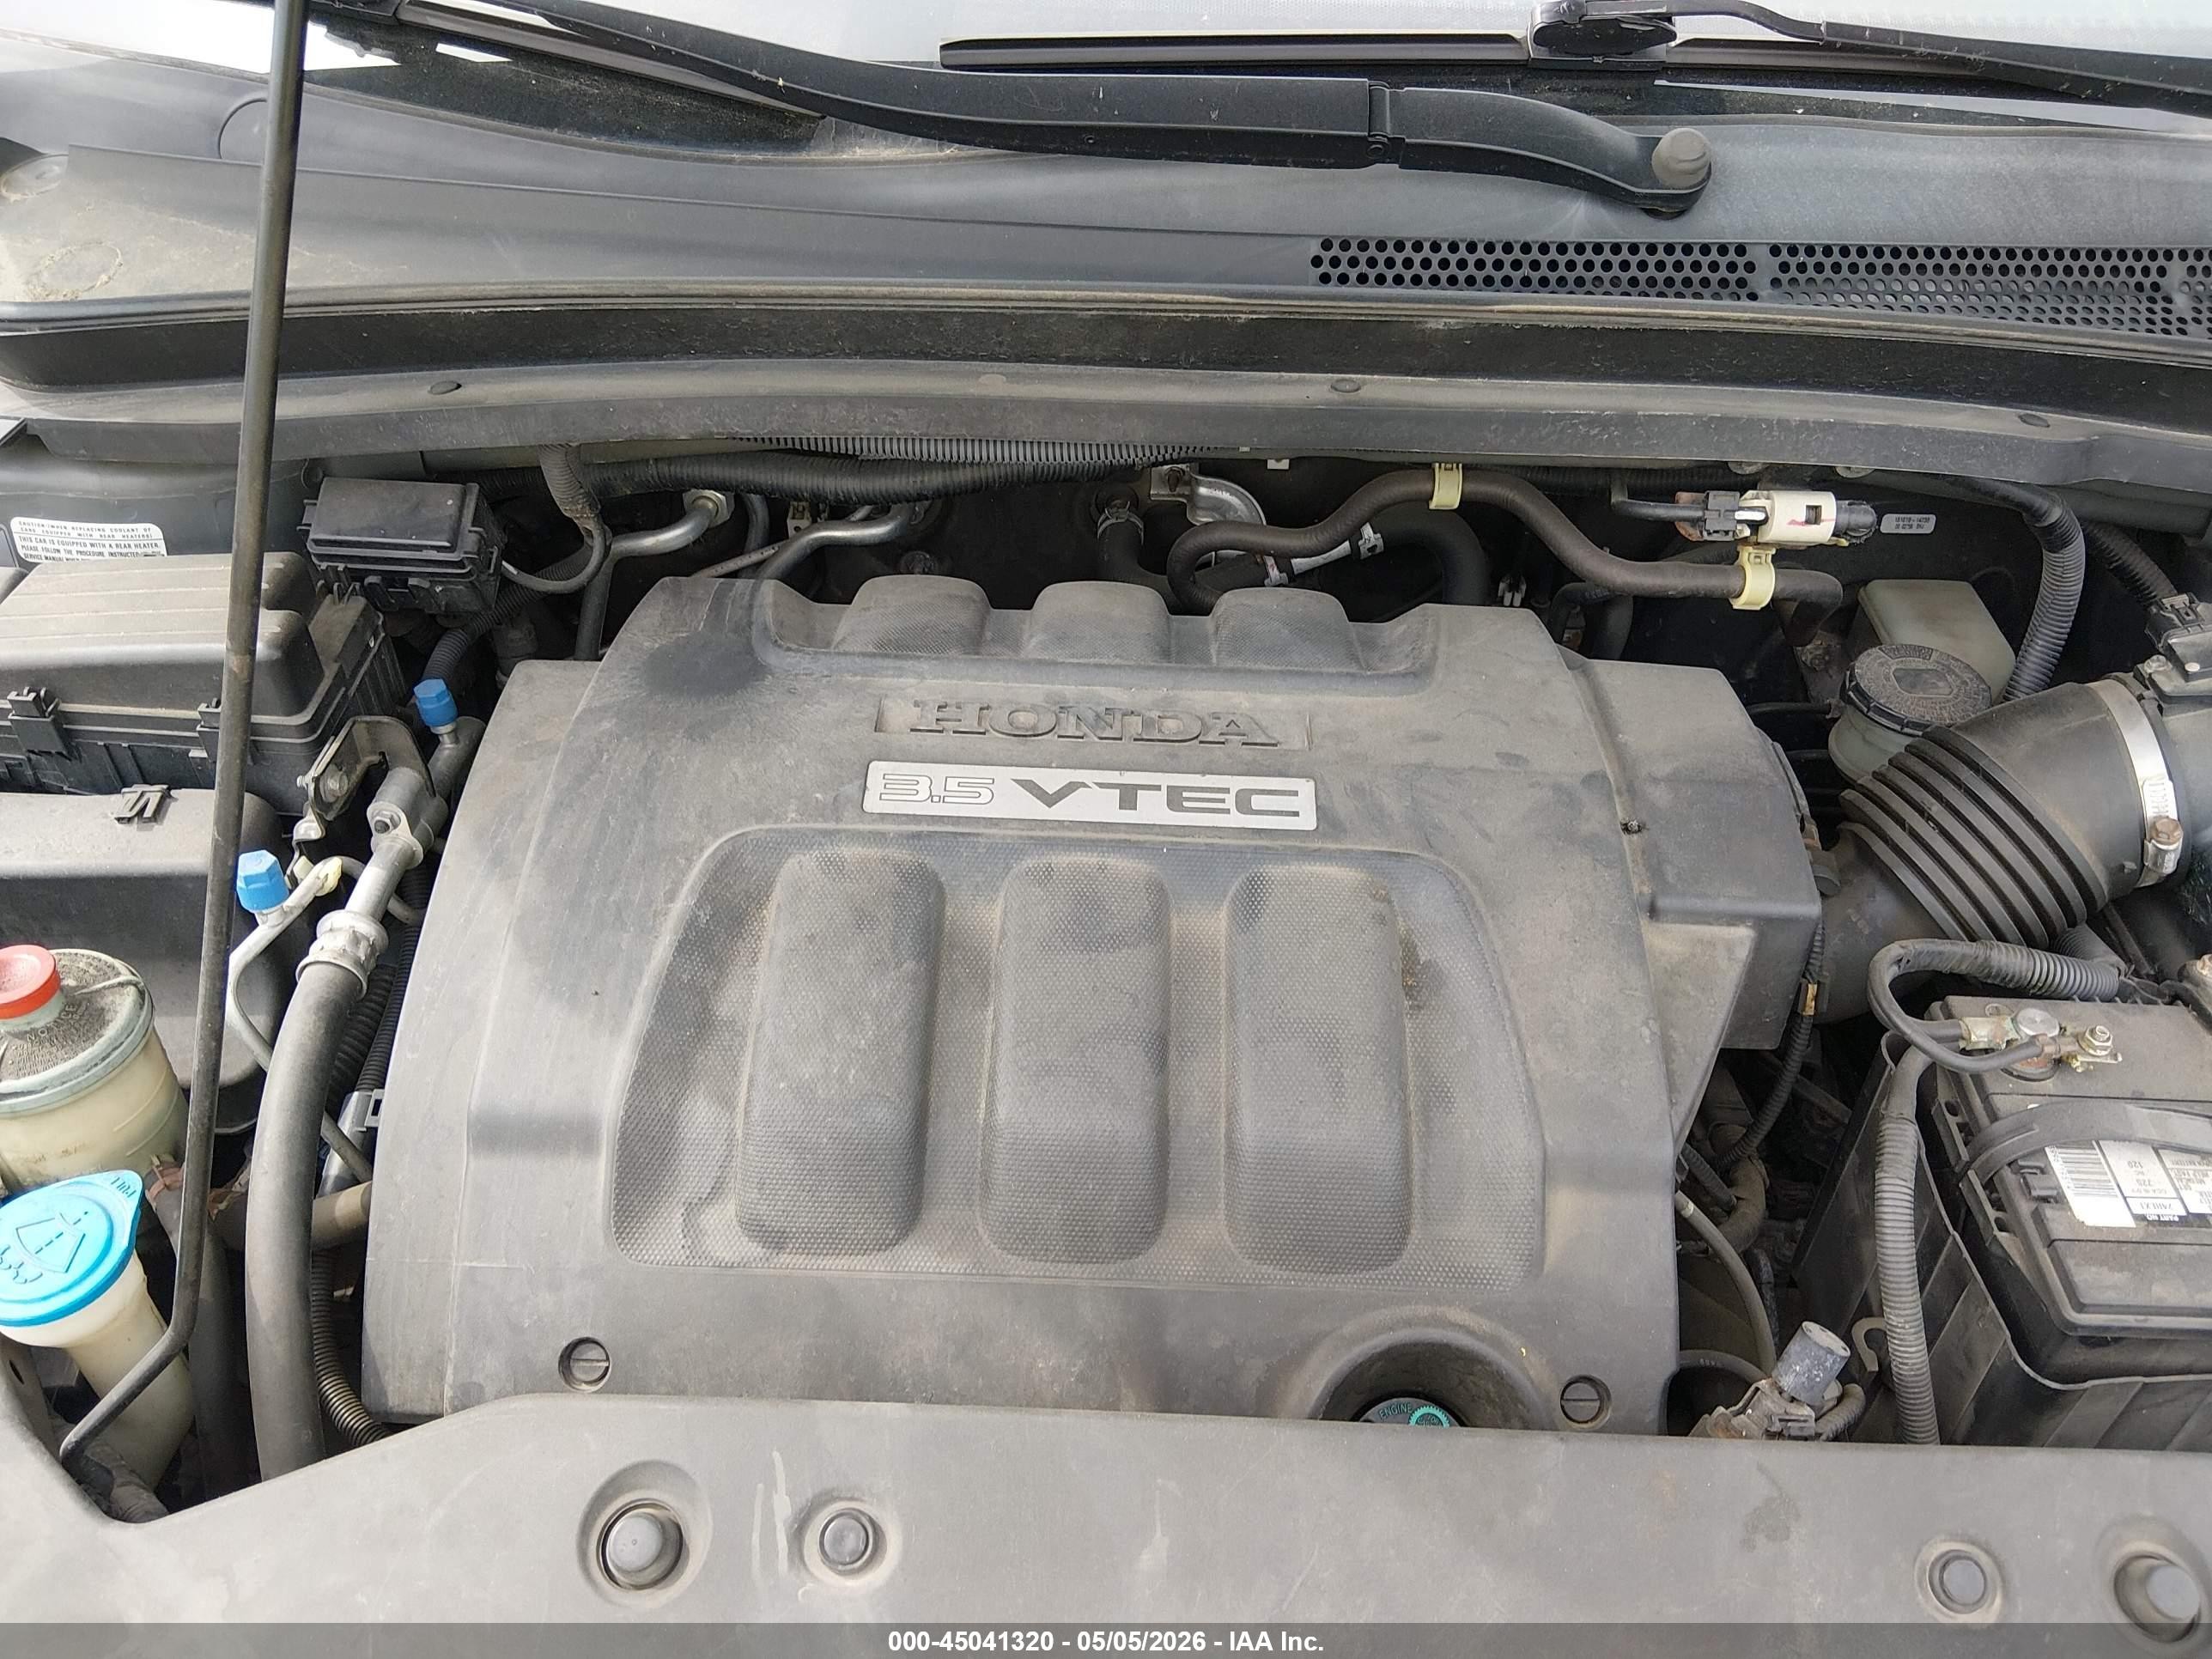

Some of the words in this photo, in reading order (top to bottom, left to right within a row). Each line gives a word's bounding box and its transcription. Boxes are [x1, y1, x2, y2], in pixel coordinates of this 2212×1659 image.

[909, 699, 1279, 747] HONDA
[879, 773, 995, 805] 3.5
[1011, 777, 1300, 817] VTEC
[27, 1004, 78, 1042] NOTICE
[1378, 1401, 1413, 1420] ENGINE
